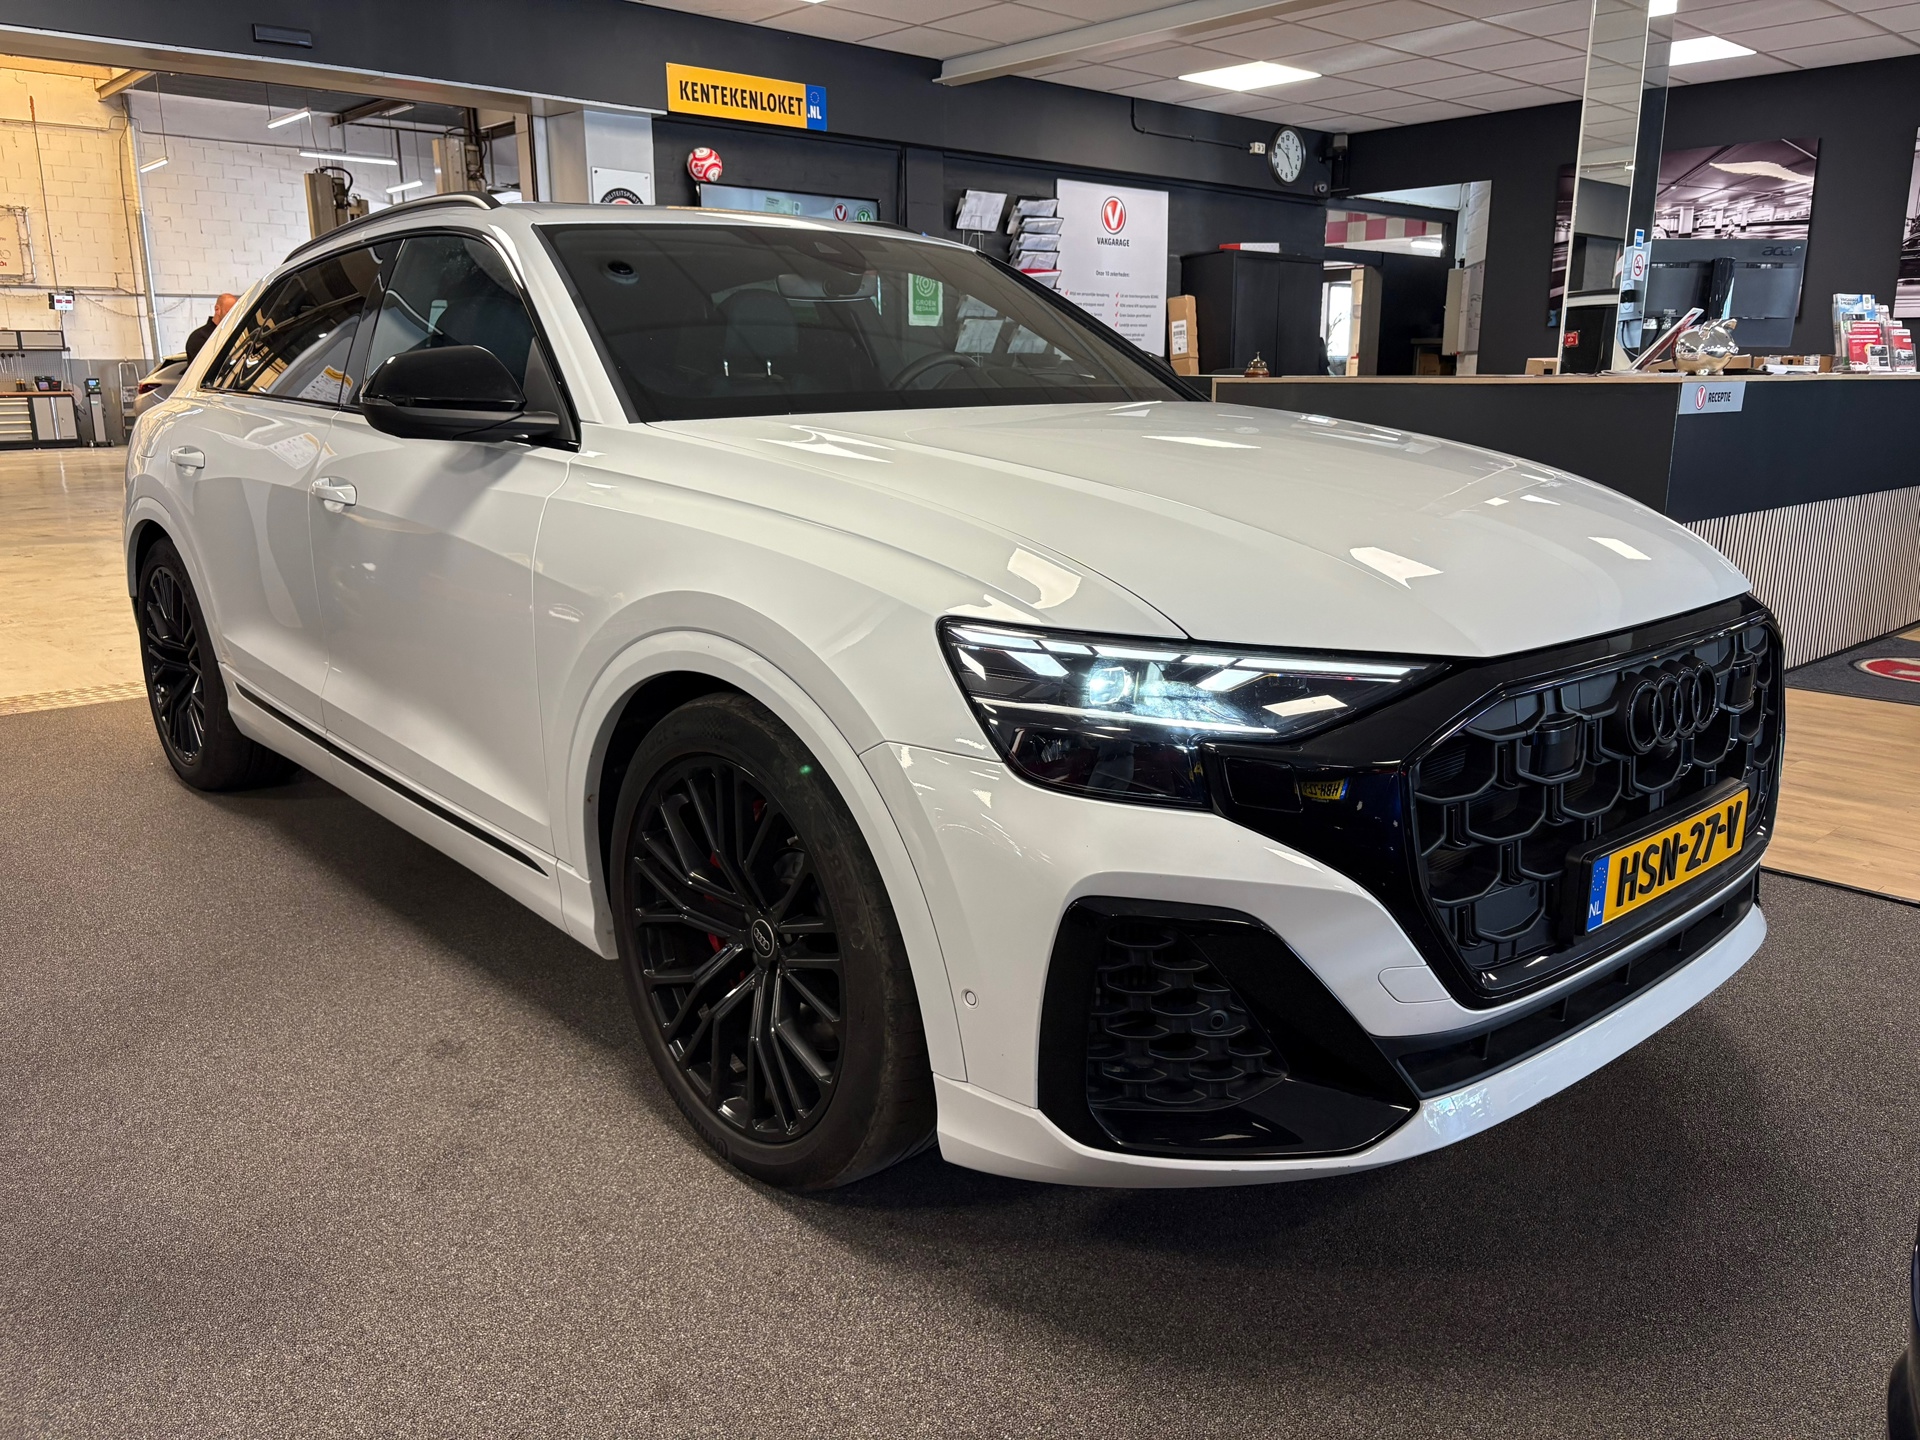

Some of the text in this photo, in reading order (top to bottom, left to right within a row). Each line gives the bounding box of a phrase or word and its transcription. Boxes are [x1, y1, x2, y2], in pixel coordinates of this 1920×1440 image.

[679, 80, 803, 116] KENTEKENLOKET
[1105, 199, 1124, 230] V
[1096, 237, 1130, 247] VAKGARAGE
[1762, 245, 1801, 256] acer
[1708, 391, 1731, 403] RECEPTIE
[1588, 800, 1743, 918] NL HSN-27-V
